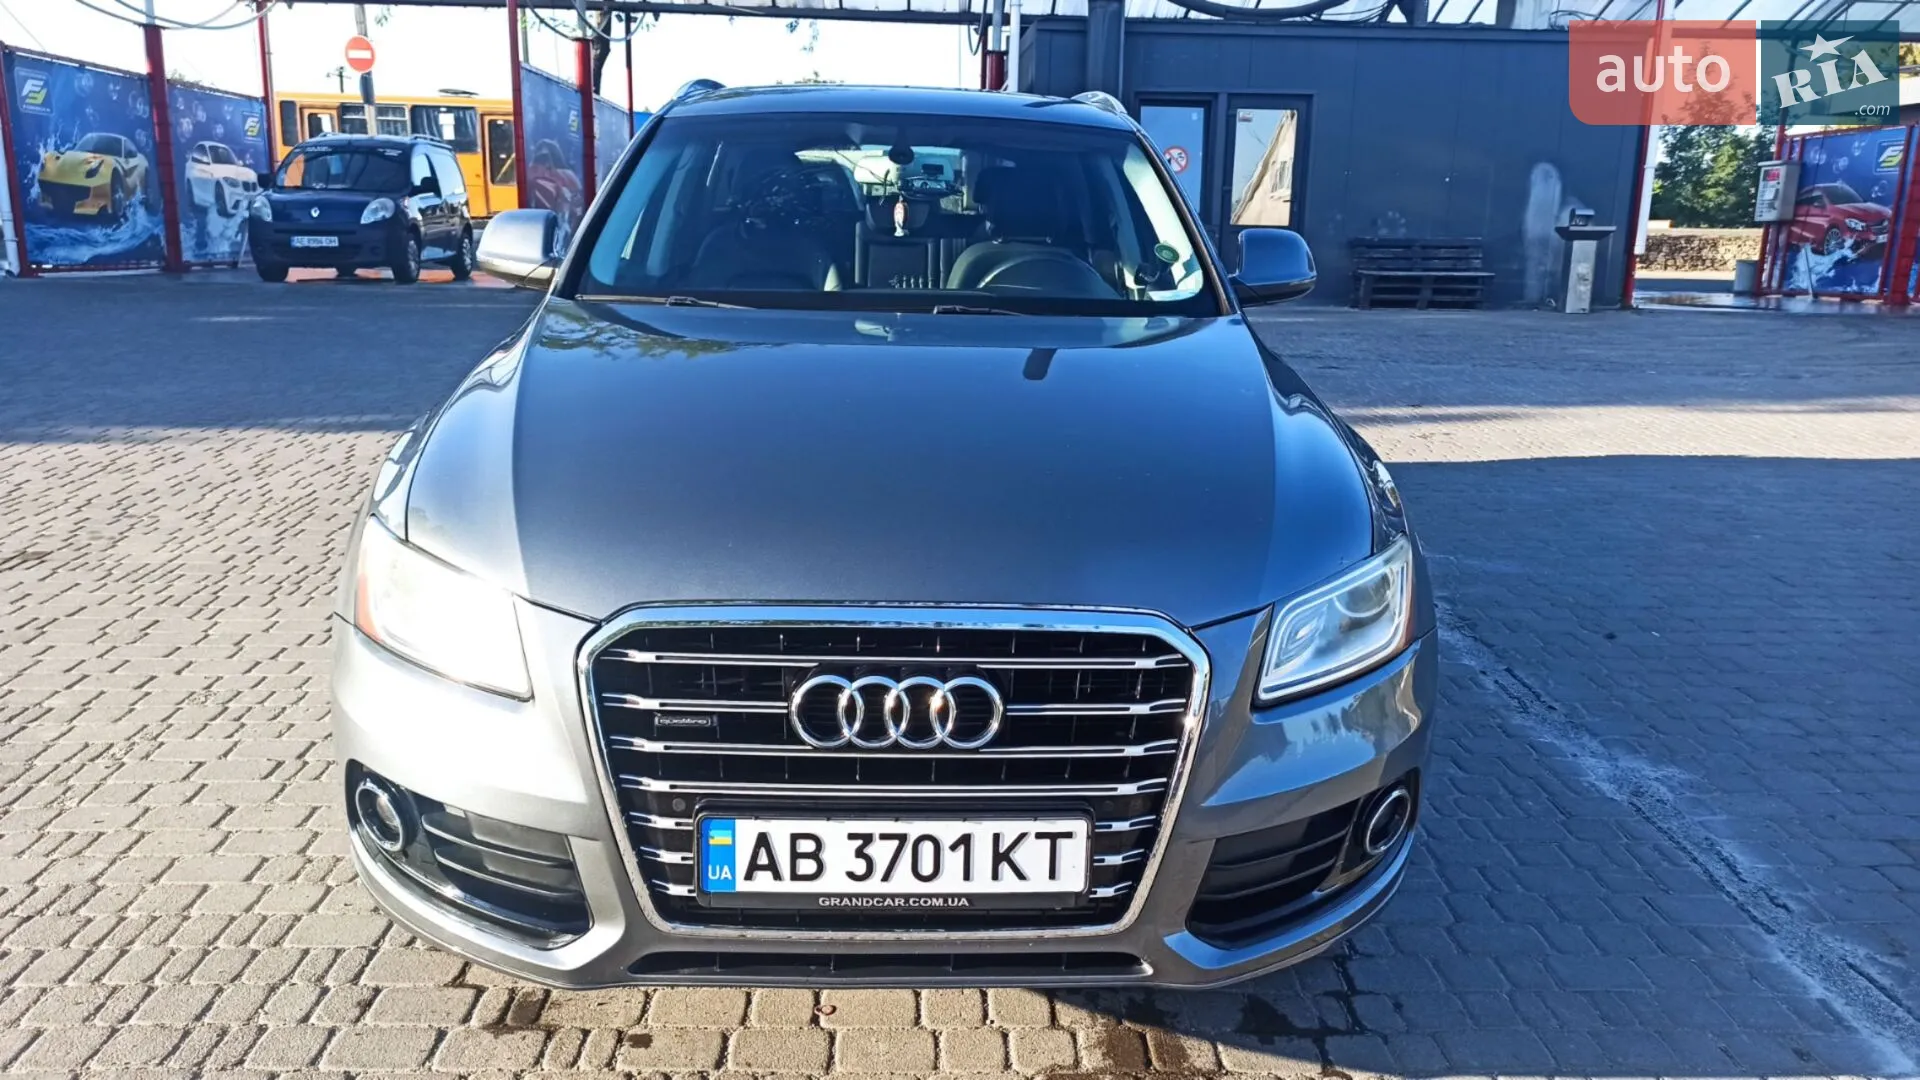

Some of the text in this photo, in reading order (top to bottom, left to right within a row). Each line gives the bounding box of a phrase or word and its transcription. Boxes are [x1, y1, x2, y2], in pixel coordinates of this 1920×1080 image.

[743, 831, 1075, 883] AB 3701 KT
[708, 865, 732, 880] UA
[818, 896, 969, 907] GRANDCAR.COM.UA
